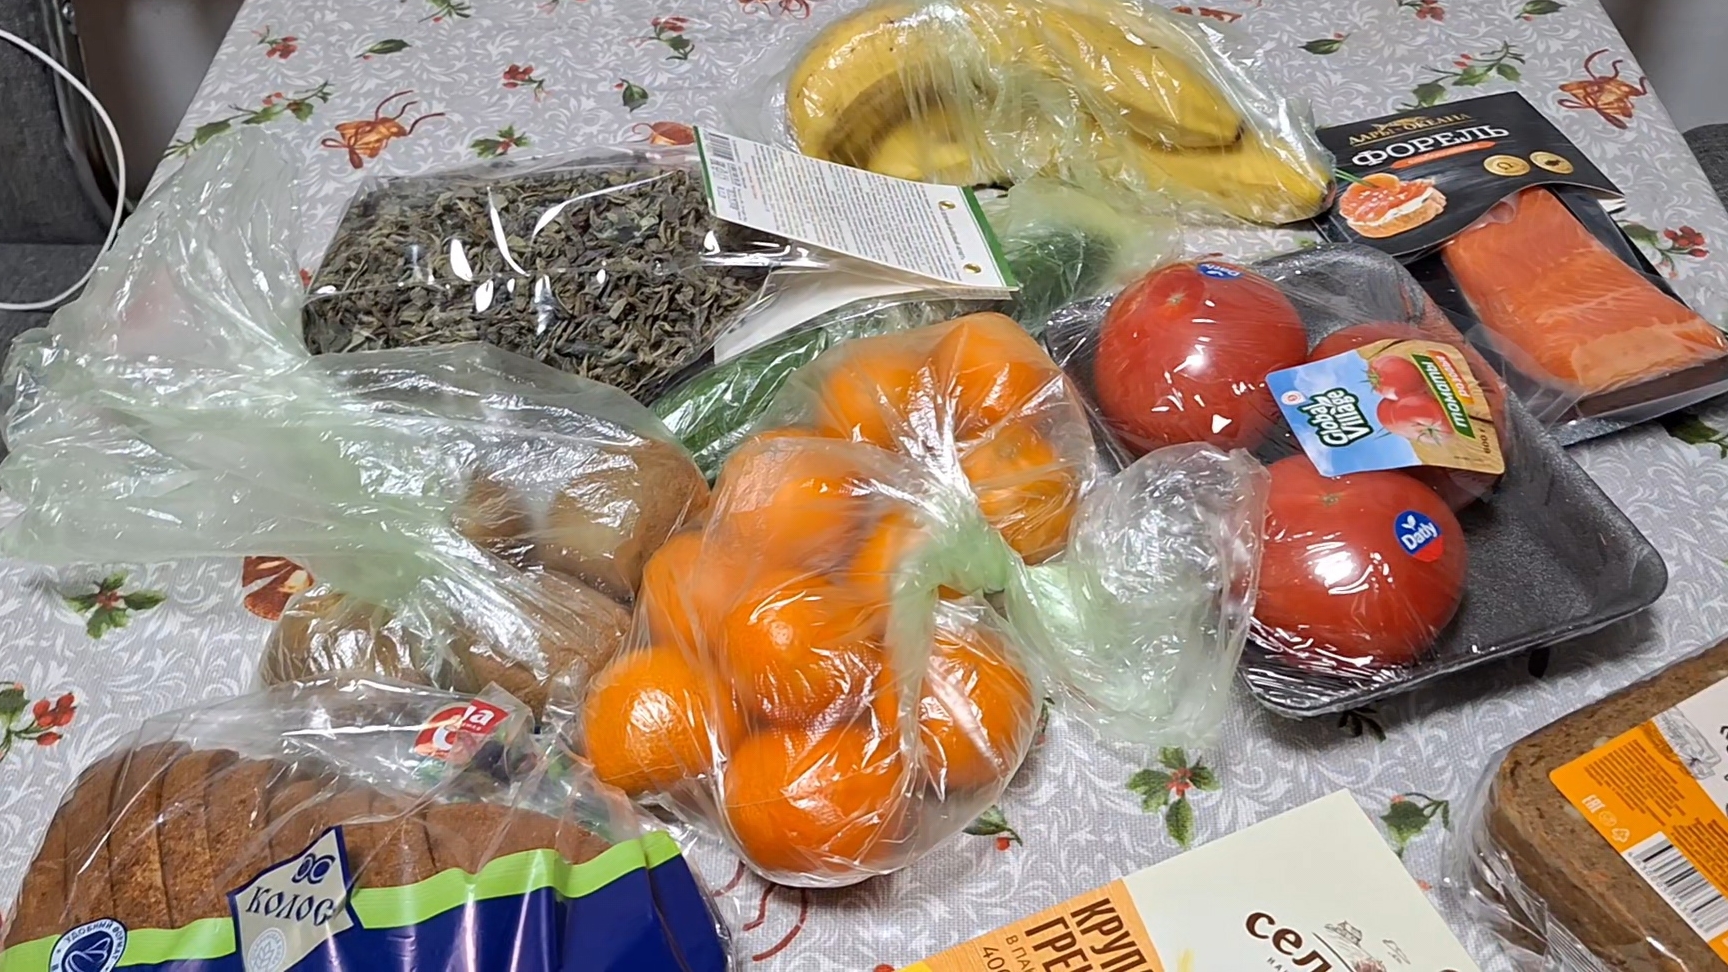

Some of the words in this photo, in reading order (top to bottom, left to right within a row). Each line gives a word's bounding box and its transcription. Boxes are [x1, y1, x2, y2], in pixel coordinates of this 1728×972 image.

[1352, 125, 1509, 166] ФОРЕЛЬ
[1301, 396, 1349, 445] Global
[1326, 389, 1371, 441] Village
[245, 886, 335, 927] КОЛОС
[1005, 934, 1019, 946] В
[1070, 897, 1155, 972] КРУП
